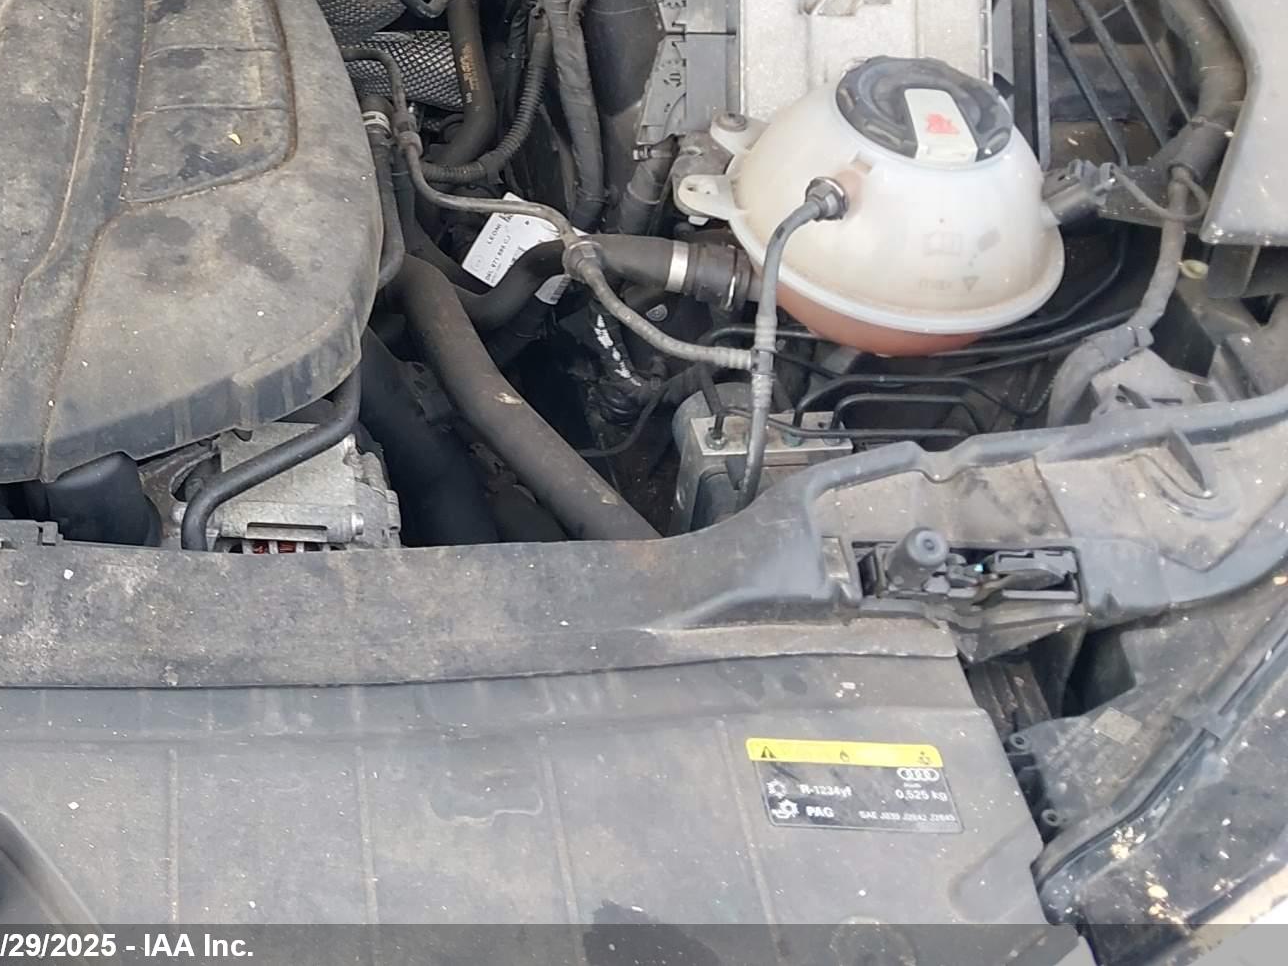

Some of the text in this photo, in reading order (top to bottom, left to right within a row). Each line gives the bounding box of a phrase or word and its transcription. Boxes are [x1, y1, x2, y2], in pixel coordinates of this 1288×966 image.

[895, 789, 948, 802] 0,525 kg
[806, 806, 835, 818] PAG
